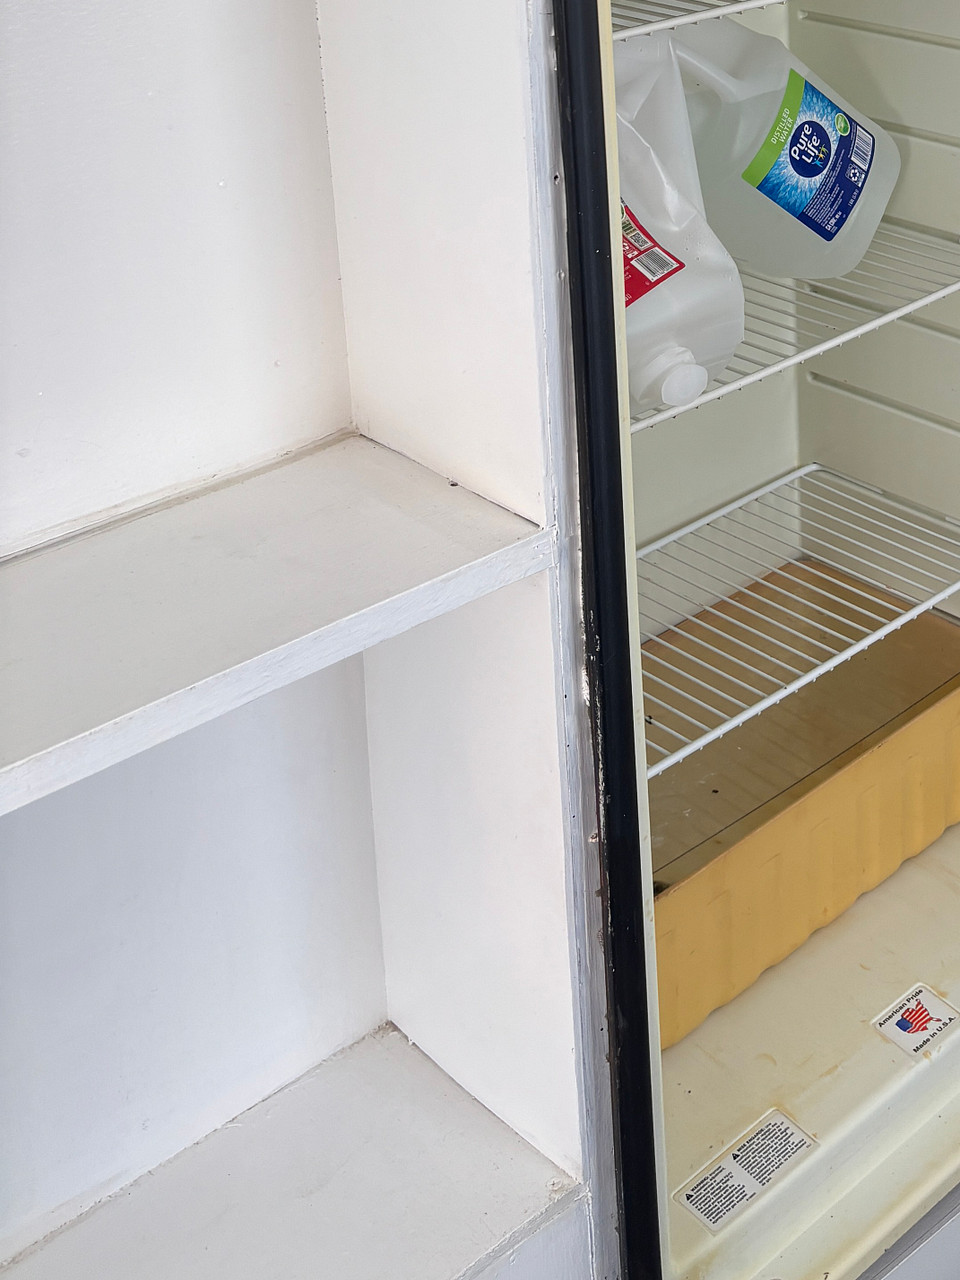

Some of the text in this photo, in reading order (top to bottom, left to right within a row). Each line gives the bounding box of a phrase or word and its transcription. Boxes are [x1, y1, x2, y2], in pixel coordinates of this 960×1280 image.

[770, 108, 790, 144] DISTILLED
[779, 117, 793, 142] WATER
[791, 124, 812, 160] Pure
[802, 135, 820, 163] Life
[878, 989, 923, 1028] American Pride
[912, 1038, 930, 1053] Made
[936, 1016, 956, 1032] U.S.A.
